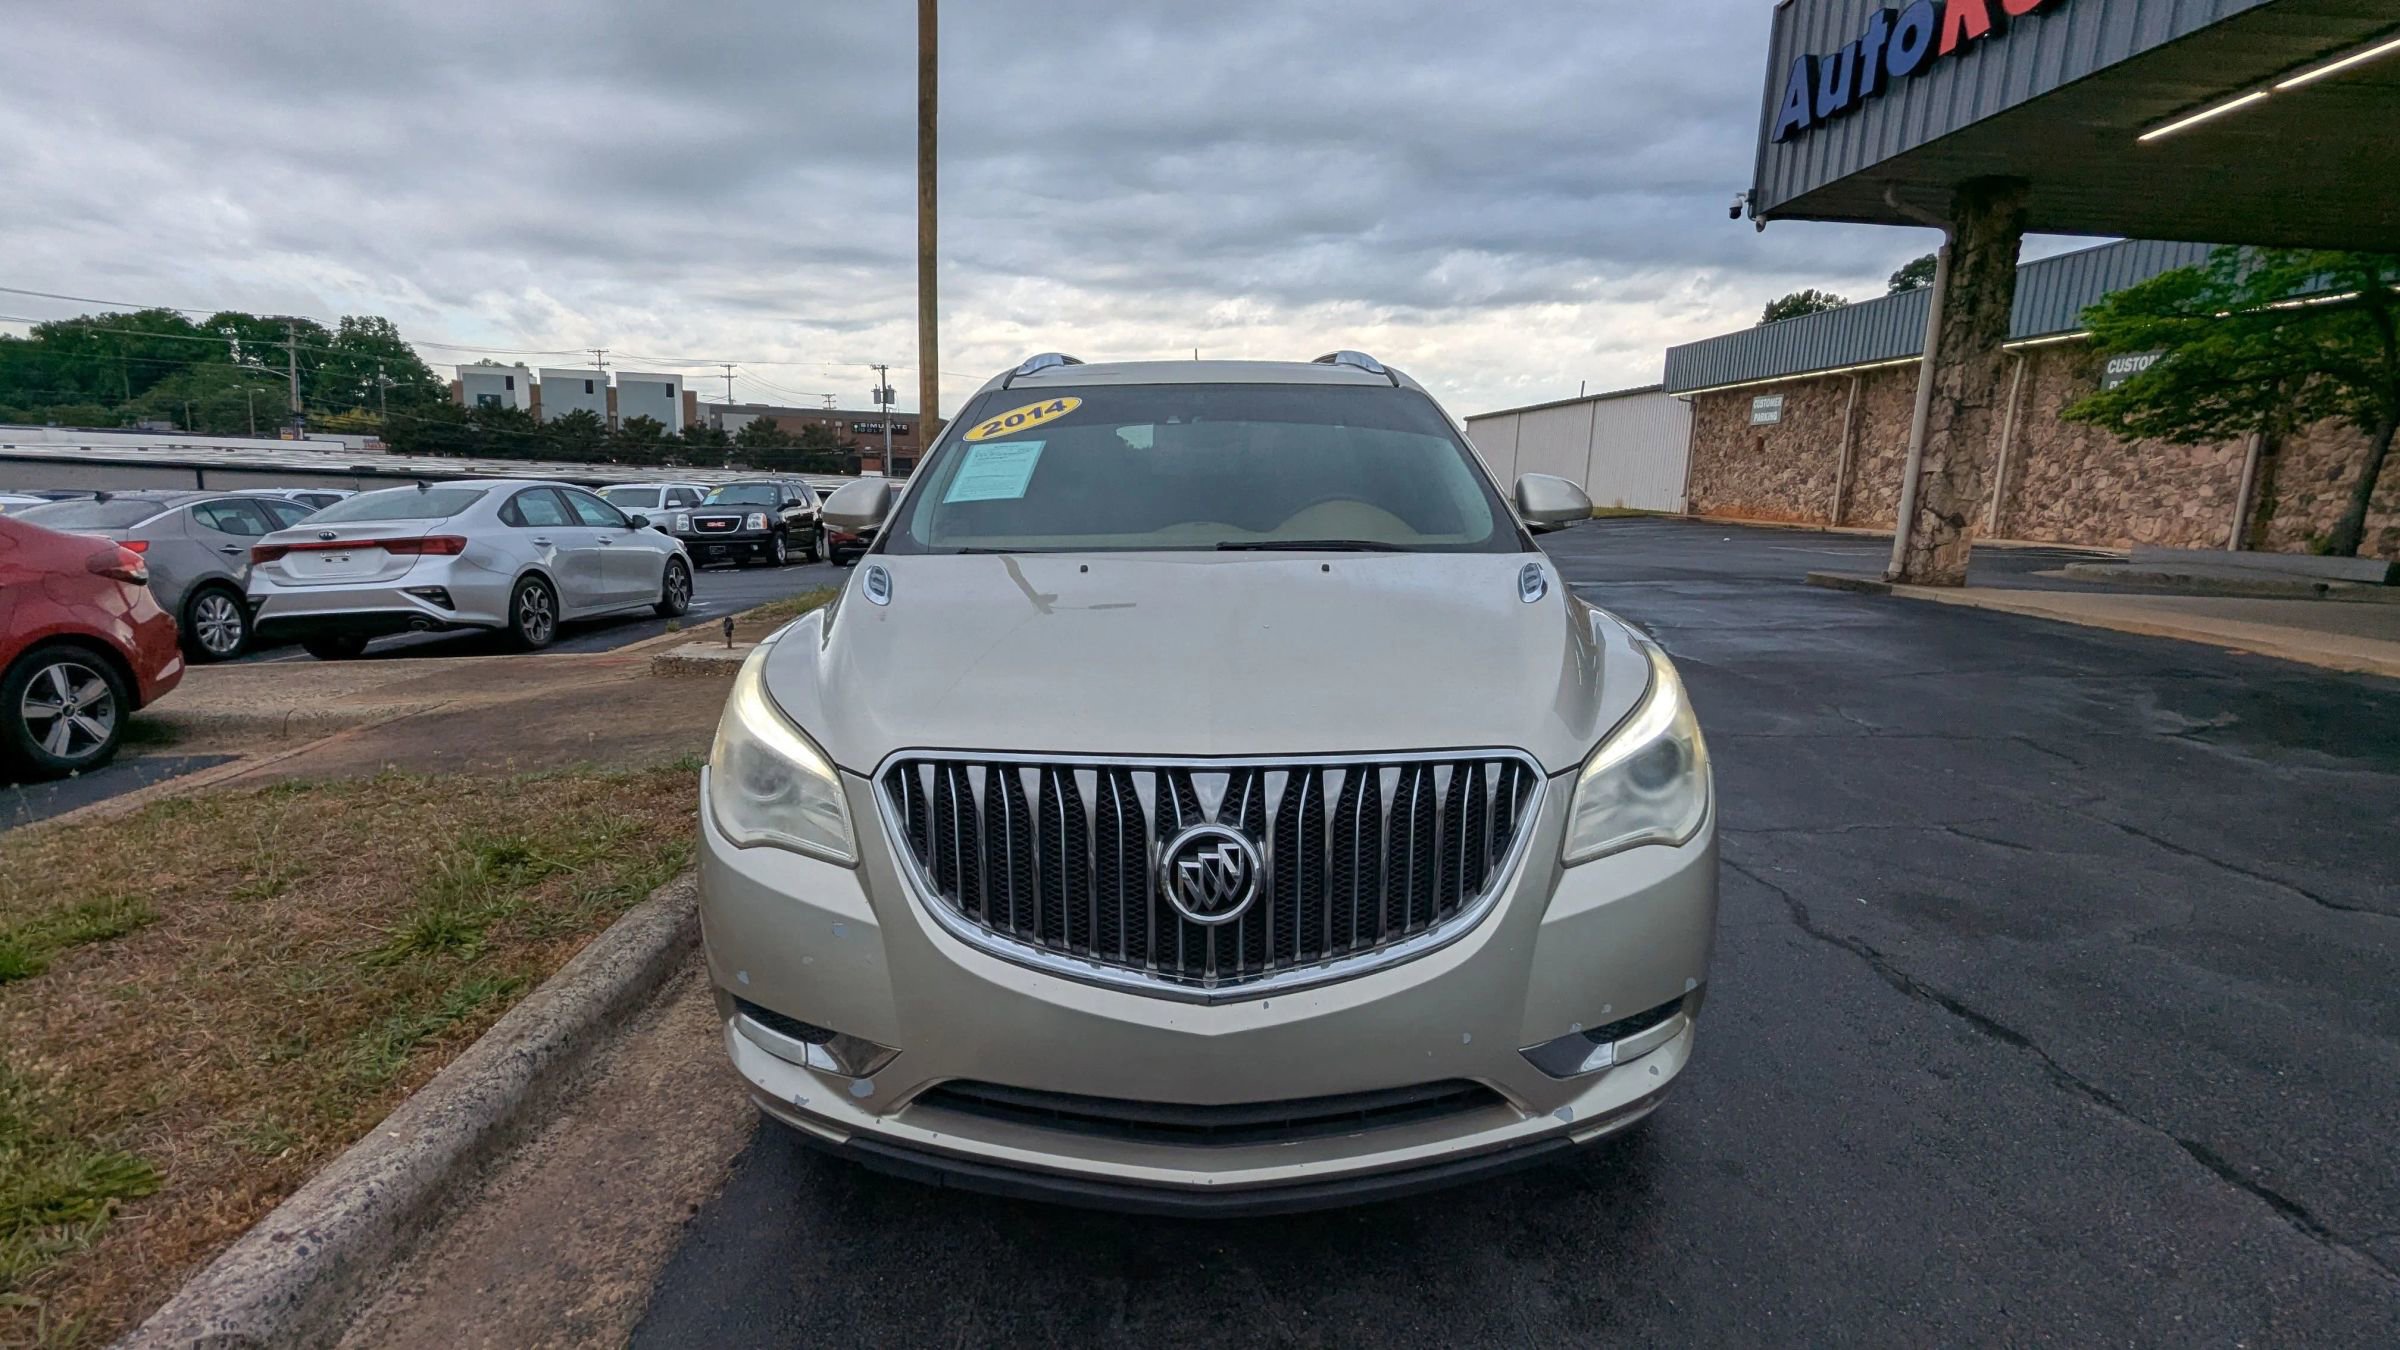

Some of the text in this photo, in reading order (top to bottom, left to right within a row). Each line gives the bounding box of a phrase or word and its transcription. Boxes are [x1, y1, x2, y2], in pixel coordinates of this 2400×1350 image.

[1772, 0, 2041, 143] Auto
[1753, 397, 1782, 409] CUSTOMER
[982, 400, 1067, 437] 2014
[1754, 411, 1778, 422] PARKING
[861, 422, 908, 430] SIMUATE
